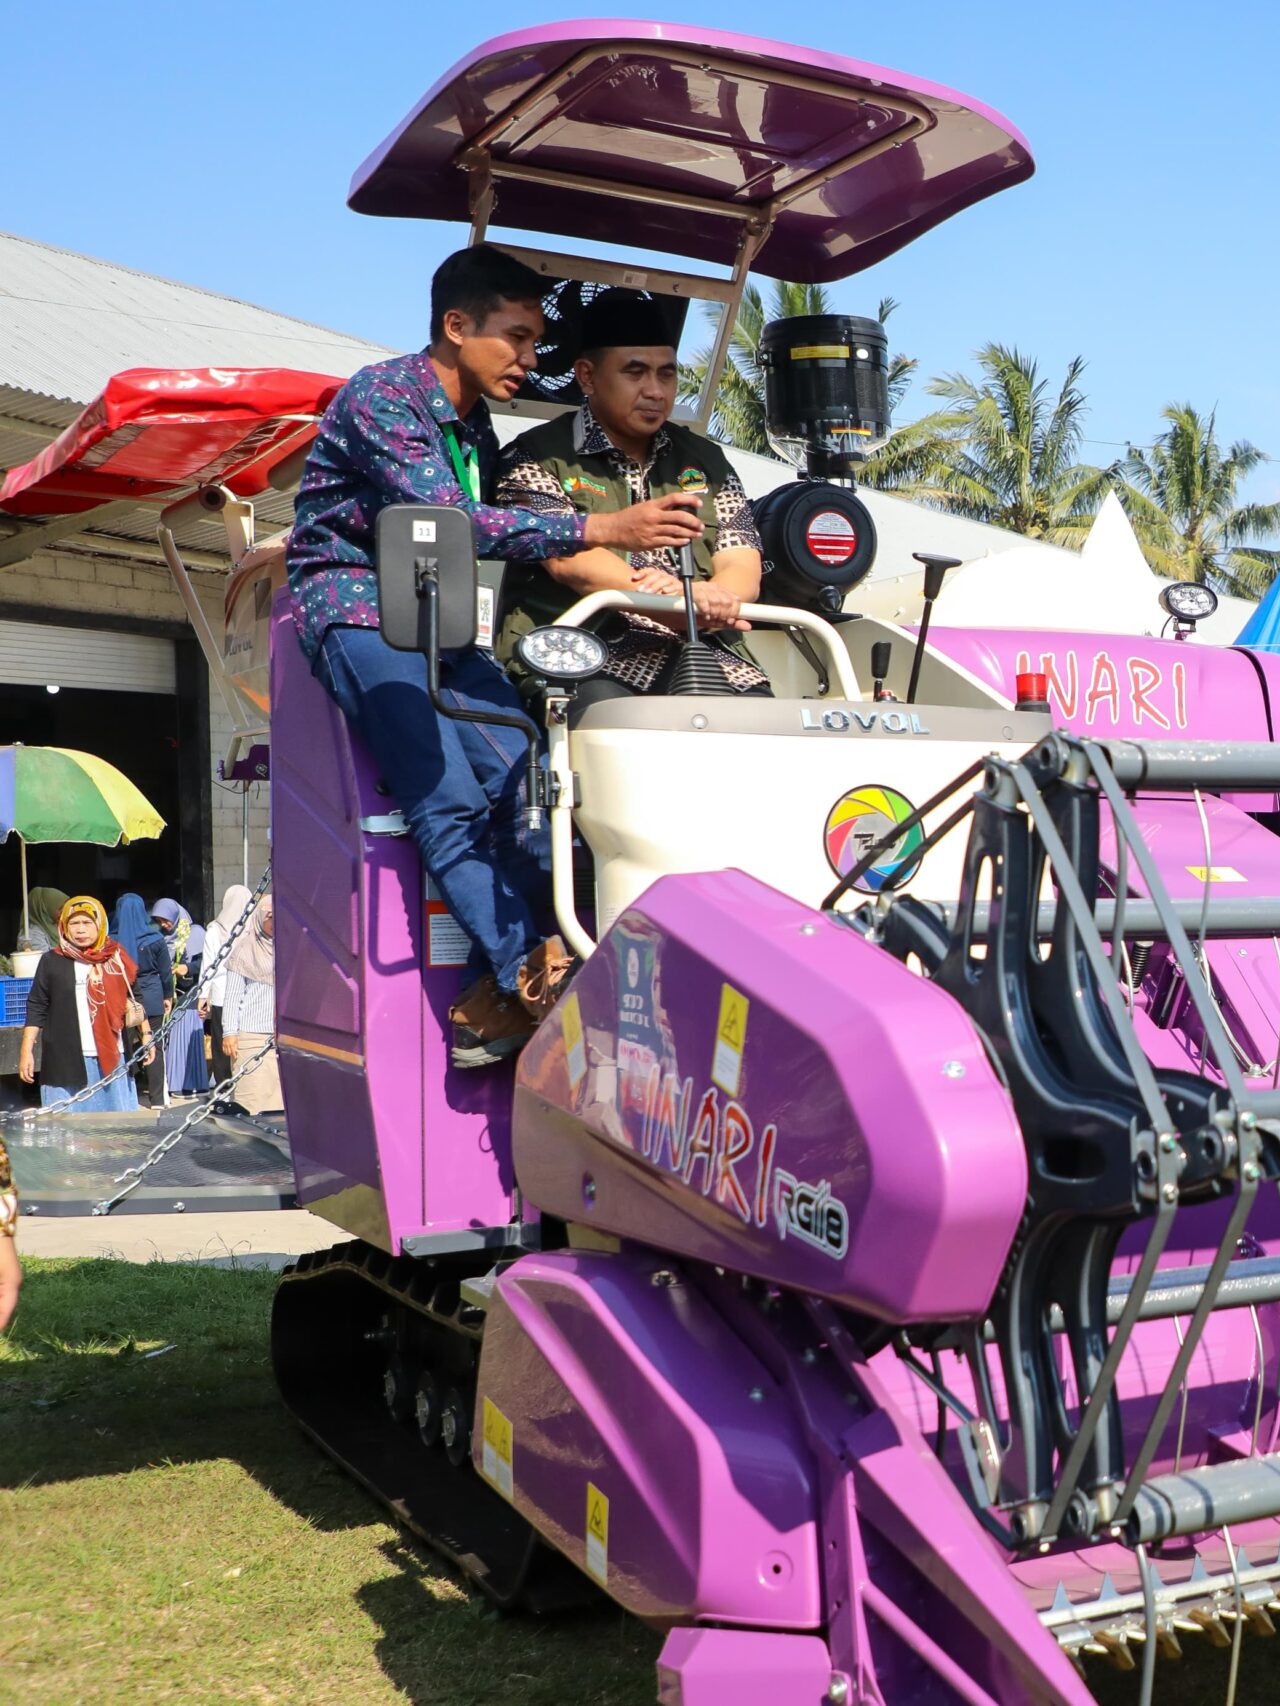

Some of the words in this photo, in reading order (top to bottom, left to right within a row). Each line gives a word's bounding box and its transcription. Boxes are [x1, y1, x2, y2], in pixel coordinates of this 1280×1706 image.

[418, 527, 431, 537] 11
[799, 707, 931, 735] LOVOL
[641, 1063, 778, 1229] INARI
